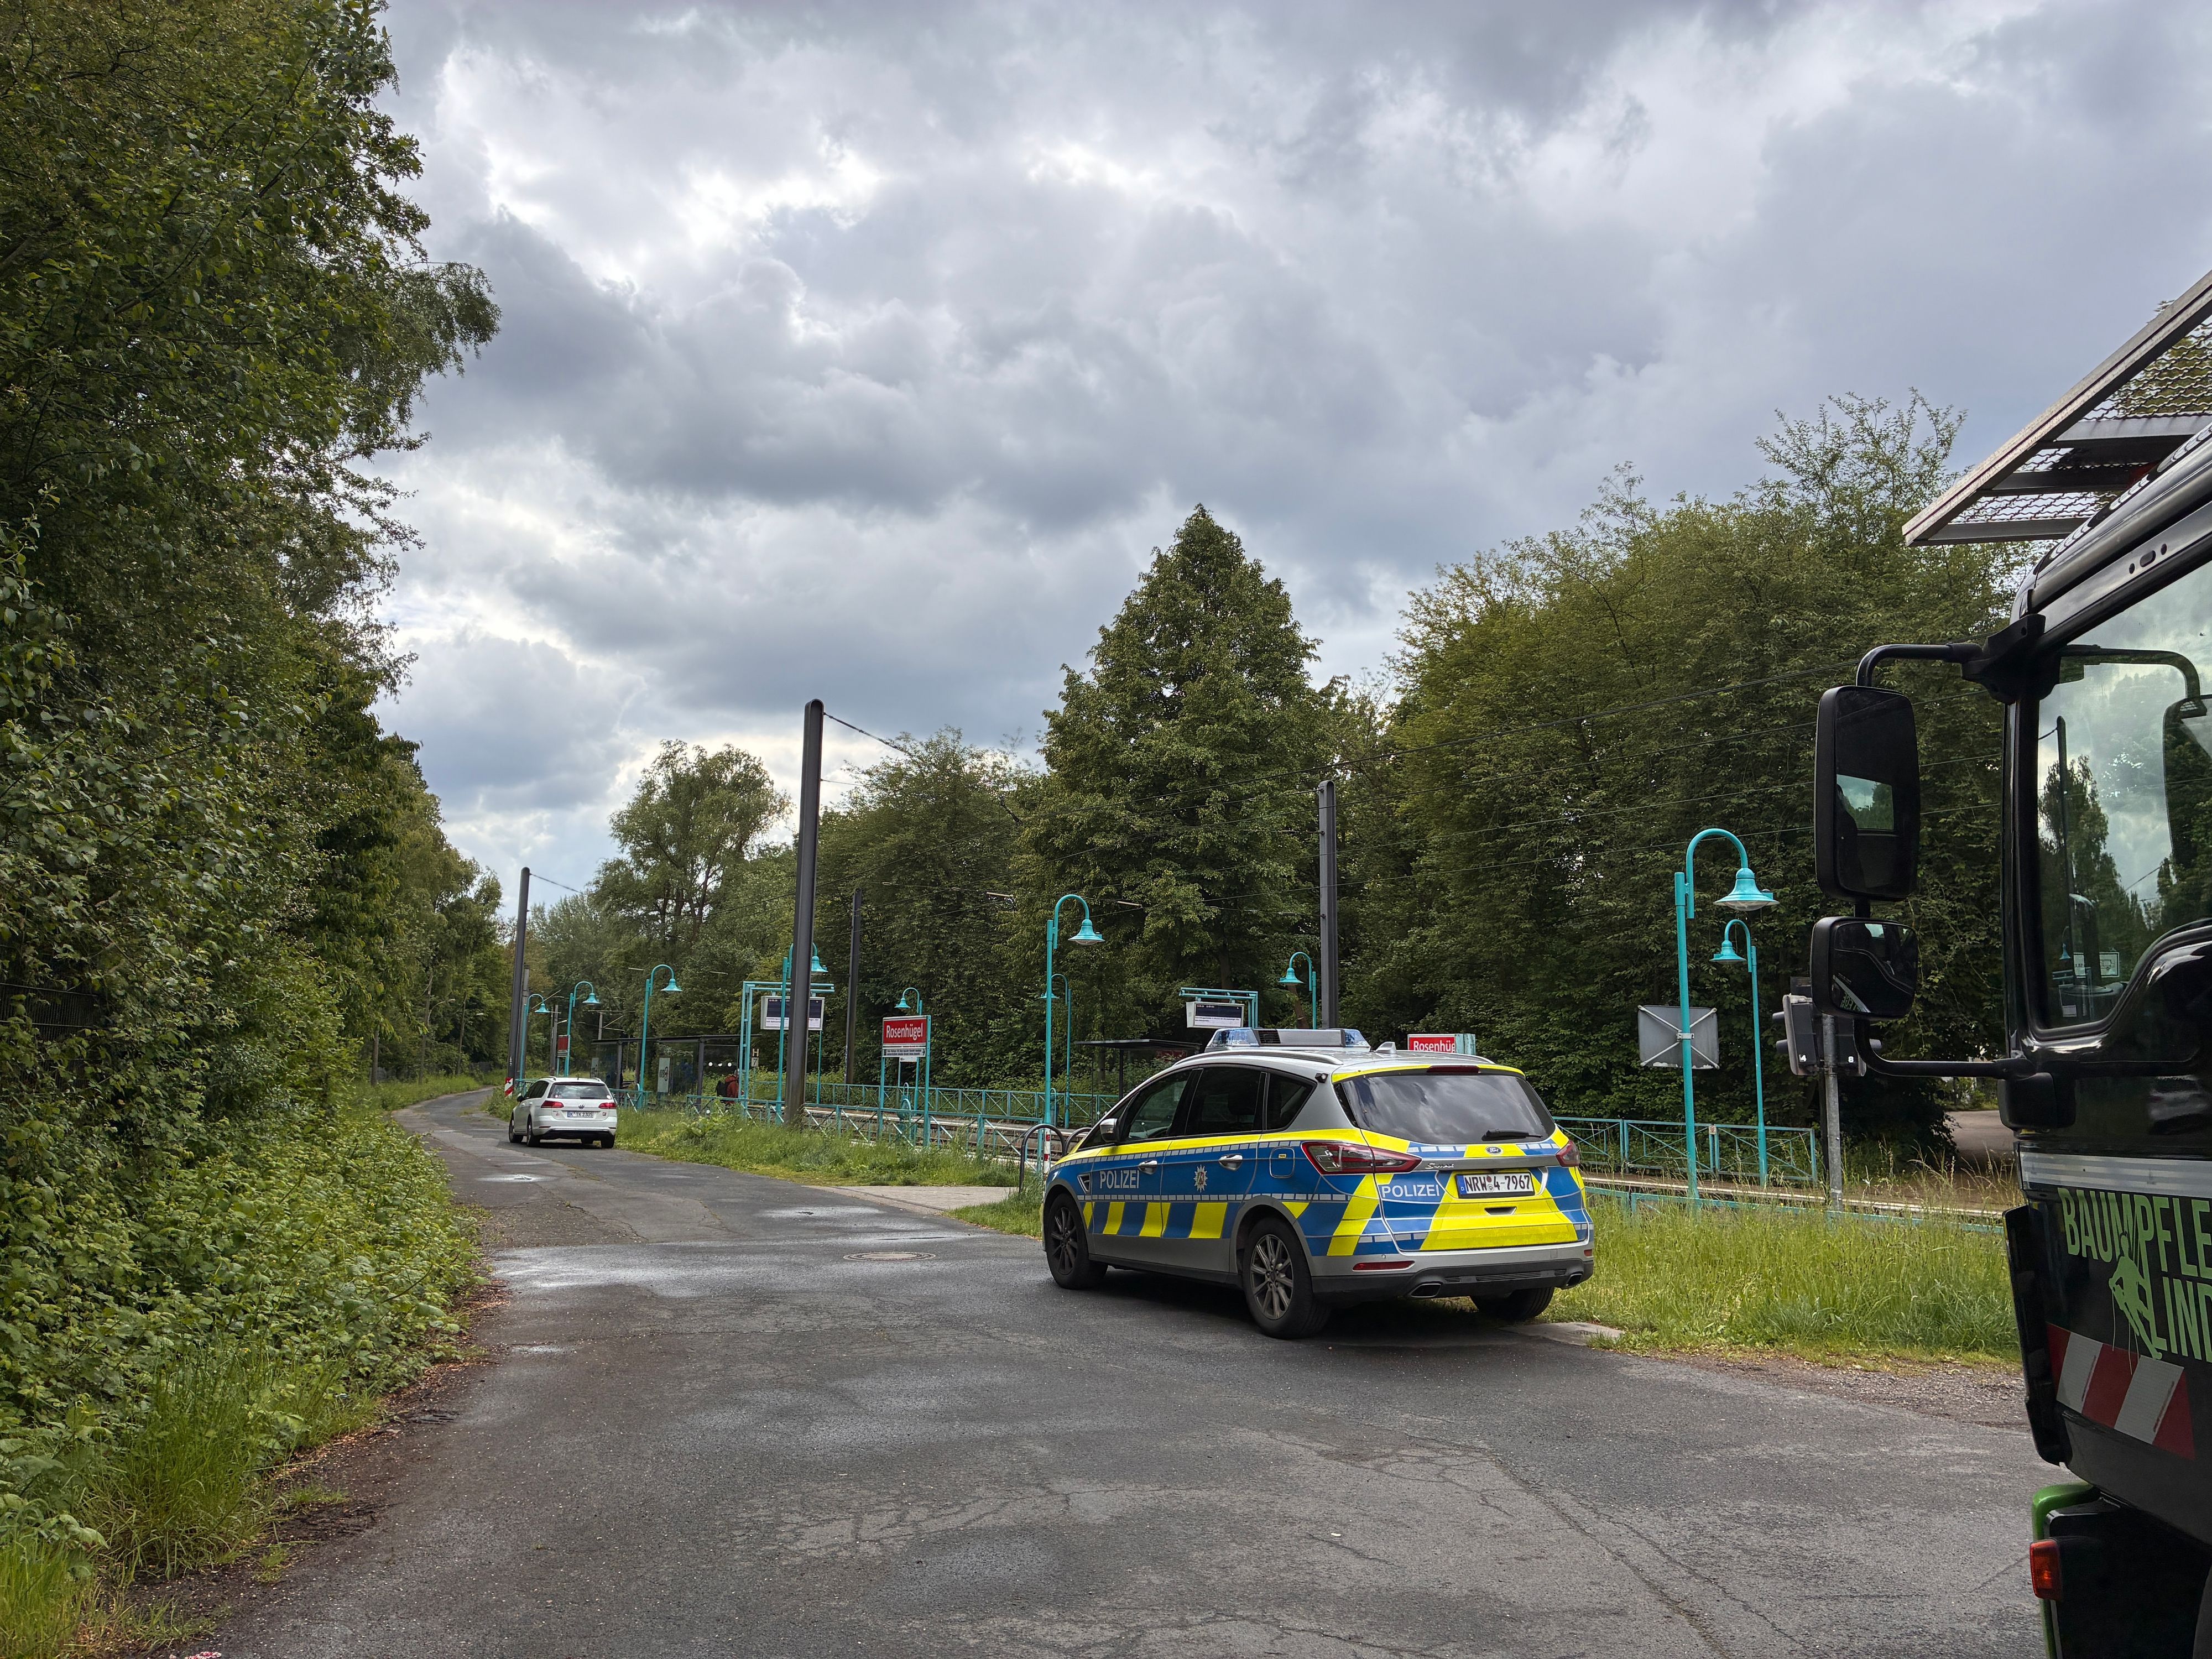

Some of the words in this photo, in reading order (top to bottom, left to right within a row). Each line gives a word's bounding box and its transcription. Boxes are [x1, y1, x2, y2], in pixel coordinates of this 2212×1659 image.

[886, 1022, 923, 1041] Rosenhügel
[752, 1048, 759, 1057] H
[1099, 1170, 1140, 1189] POLIZEI
[1464, 1176, 1487, 1192] NRW
[1494, 1175, 1530, 1190] 4-7967
[1382, 1184, 1440, 1198] POLIZEI
